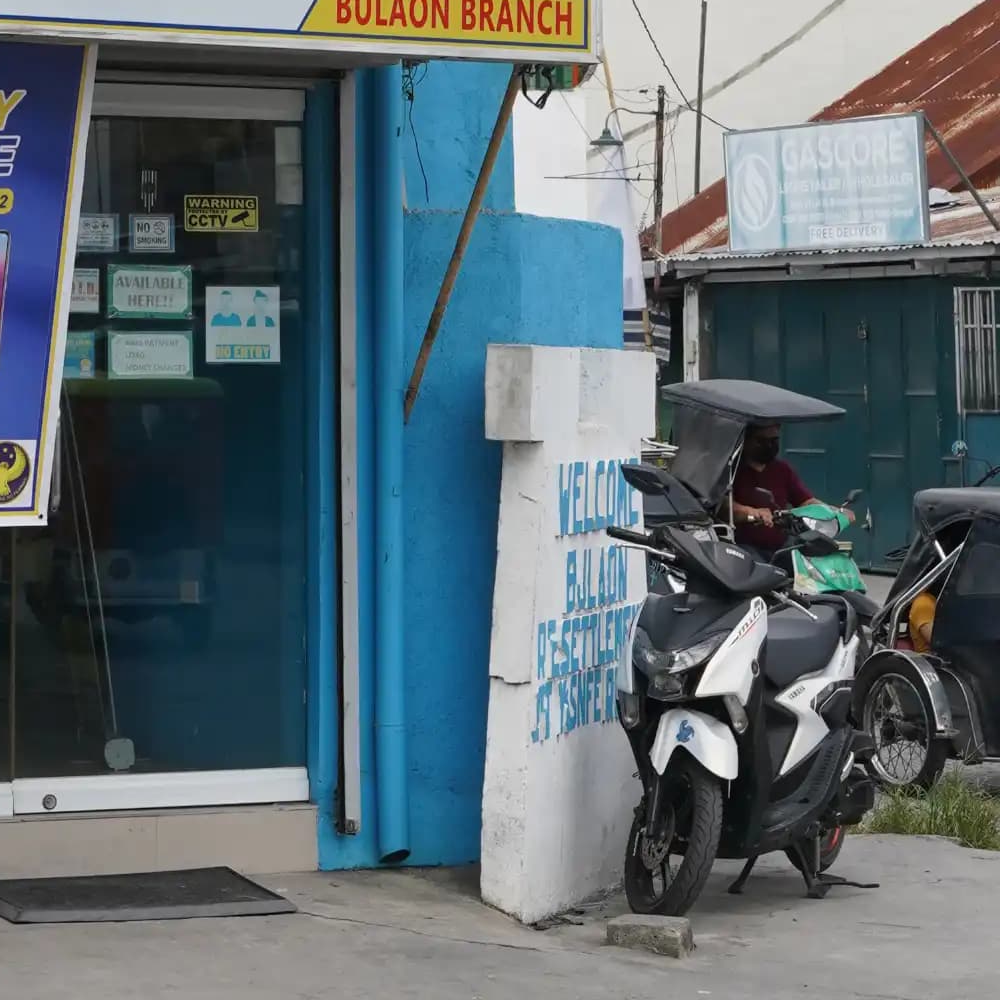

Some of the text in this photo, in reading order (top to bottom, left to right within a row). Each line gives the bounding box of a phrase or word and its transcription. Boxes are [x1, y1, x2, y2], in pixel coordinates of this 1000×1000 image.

[188, 198, 255, 209] WARNING
[188, 214, 228, 227] CCTV
[136, 222, 151, 233] NO
[136, 236, 167, 245] SMOKING
[115, 276, 186, 290] AVAILABLE
